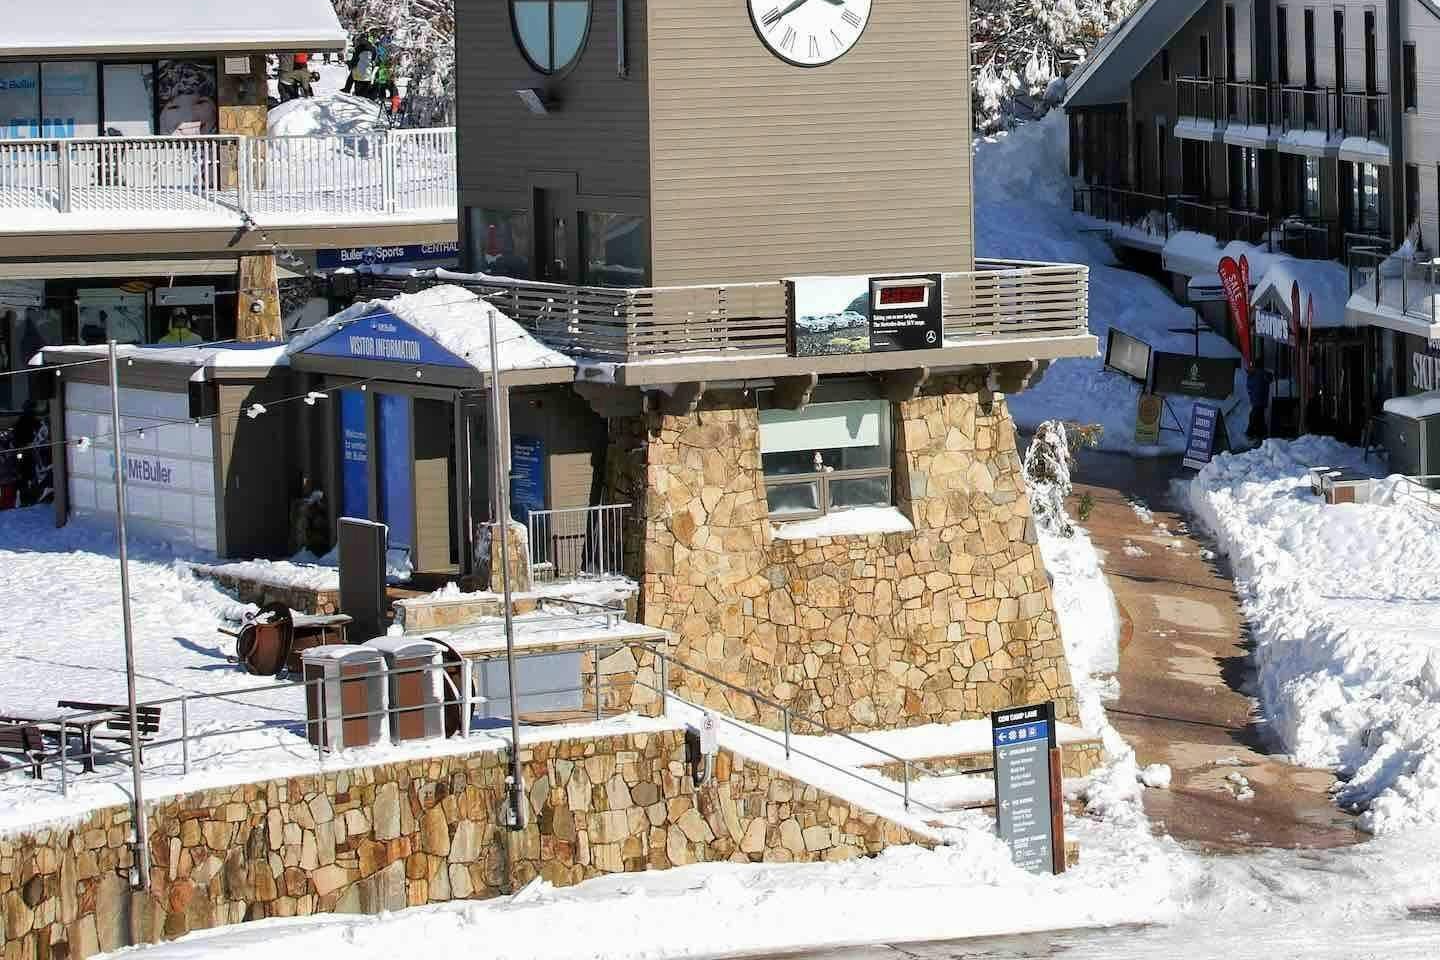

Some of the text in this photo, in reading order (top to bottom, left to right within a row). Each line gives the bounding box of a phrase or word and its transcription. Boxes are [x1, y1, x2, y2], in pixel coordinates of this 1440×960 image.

[340, 249, 363, 262] Buller
[376, 247, 405, 259] Sports
[349, 335, 421, 361] VISITOR INFORMATION
[1412, 351, 1433, 392] SKI
